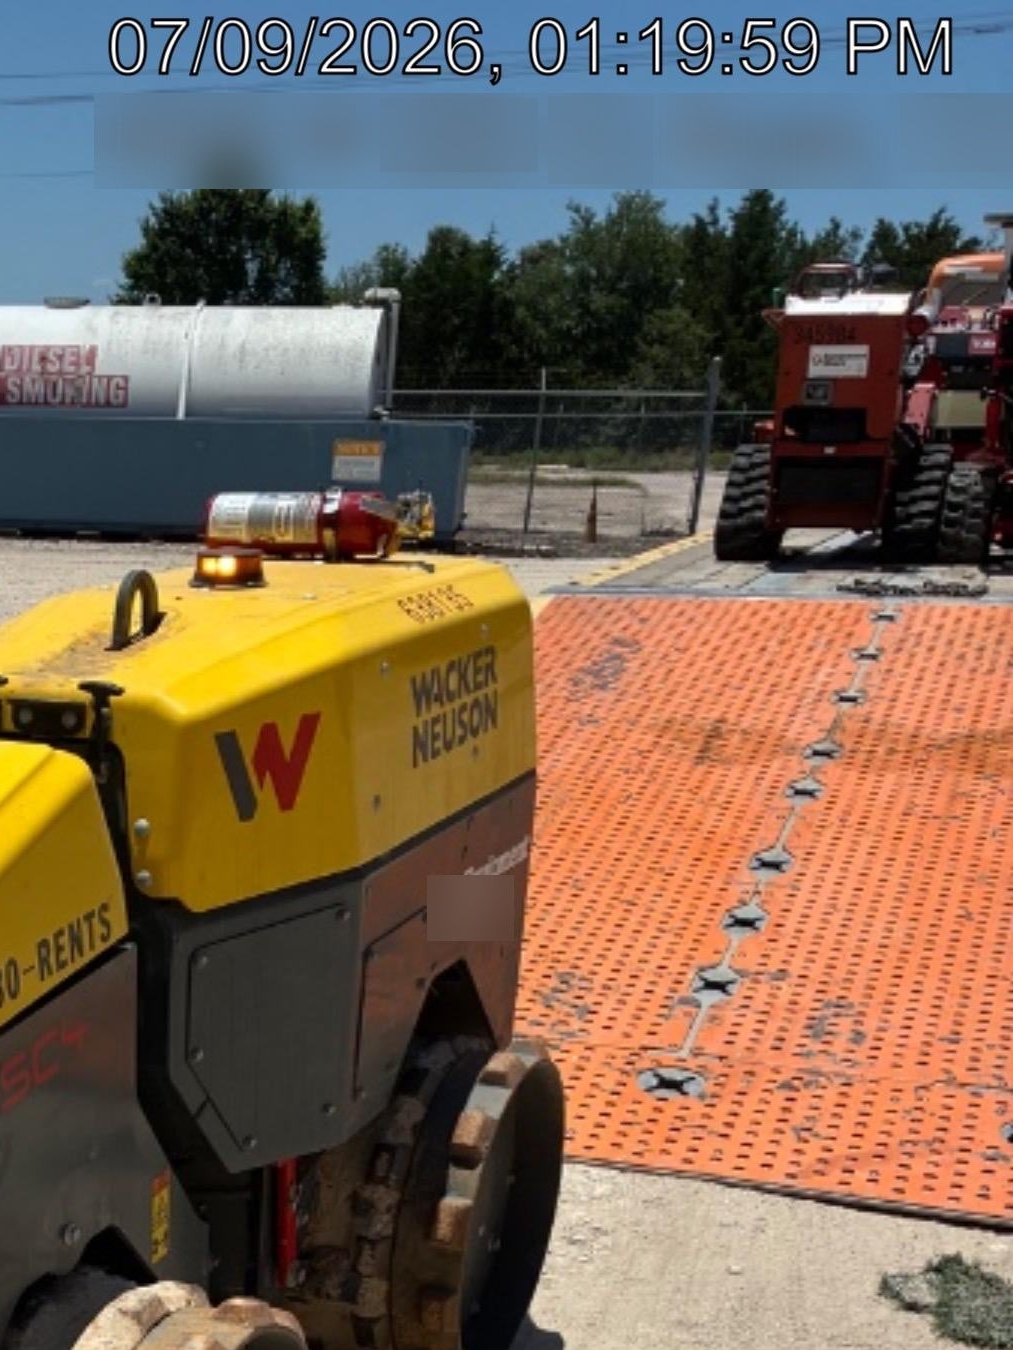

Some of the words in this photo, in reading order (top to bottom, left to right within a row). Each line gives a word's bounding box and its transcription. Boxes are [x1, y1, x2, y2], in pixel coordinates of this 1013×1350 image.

[2, 346, 94, 373] DIESEL
[410, 645, 498, 718] WACKER
[412, 688, 498, 769] NEUSON
